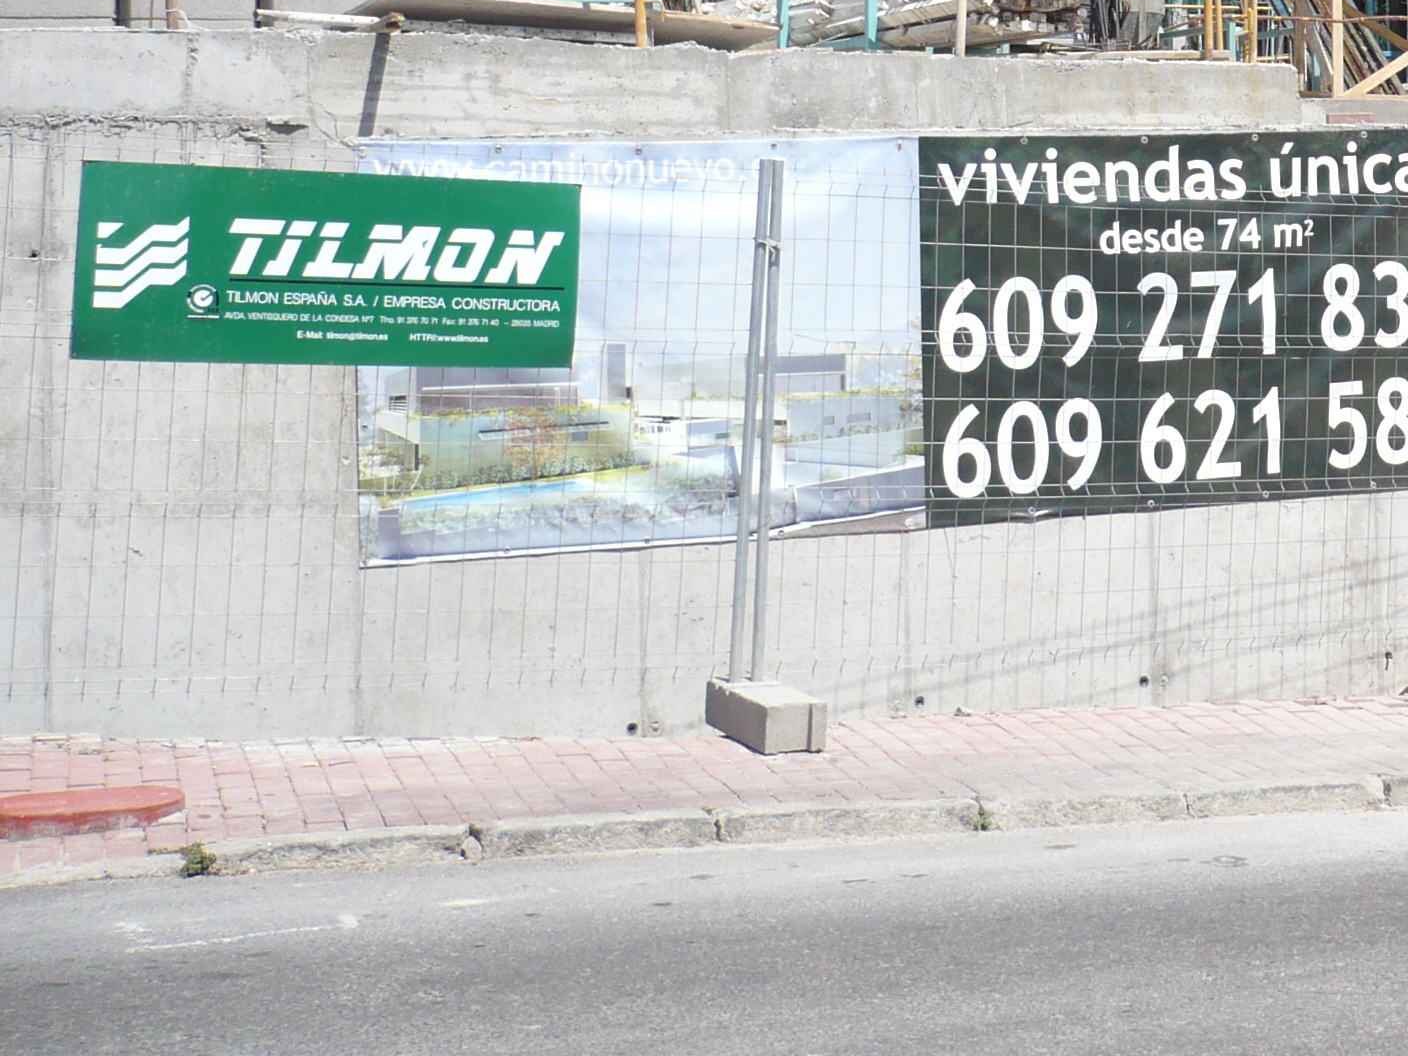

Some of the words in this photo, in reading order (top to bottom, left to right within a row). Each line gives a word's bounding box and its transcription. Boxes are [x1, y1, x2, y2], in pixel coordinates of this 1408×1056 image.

[937, 145, 1247, 206] viviendas
[229, 218, 565, 285] TILMON
[1099, 220, 1205, 254] desde
[1217, 217, 1261, 250] 74
[1273, 219, 1314, 248] m²
[226, 290, 279, 304] TILMON
[283, 291, 338, 306] ESPAÑA
[343, 294, 367, 307] S.A.
[372, 295, 379, 307] /
[384, 295, 446, 309] EMPRESA
[452, 297, 561, 312] CONSTRUCTORA
[300, 313, 311, 322] DE
[312, 314, 323, 322] LA
[938, 274, 1098, 373] 609
[1136, 268, 1276, 362] 271
[942, 397, 1102, 498] 609
[1140, 386, 1281, 484] 621
